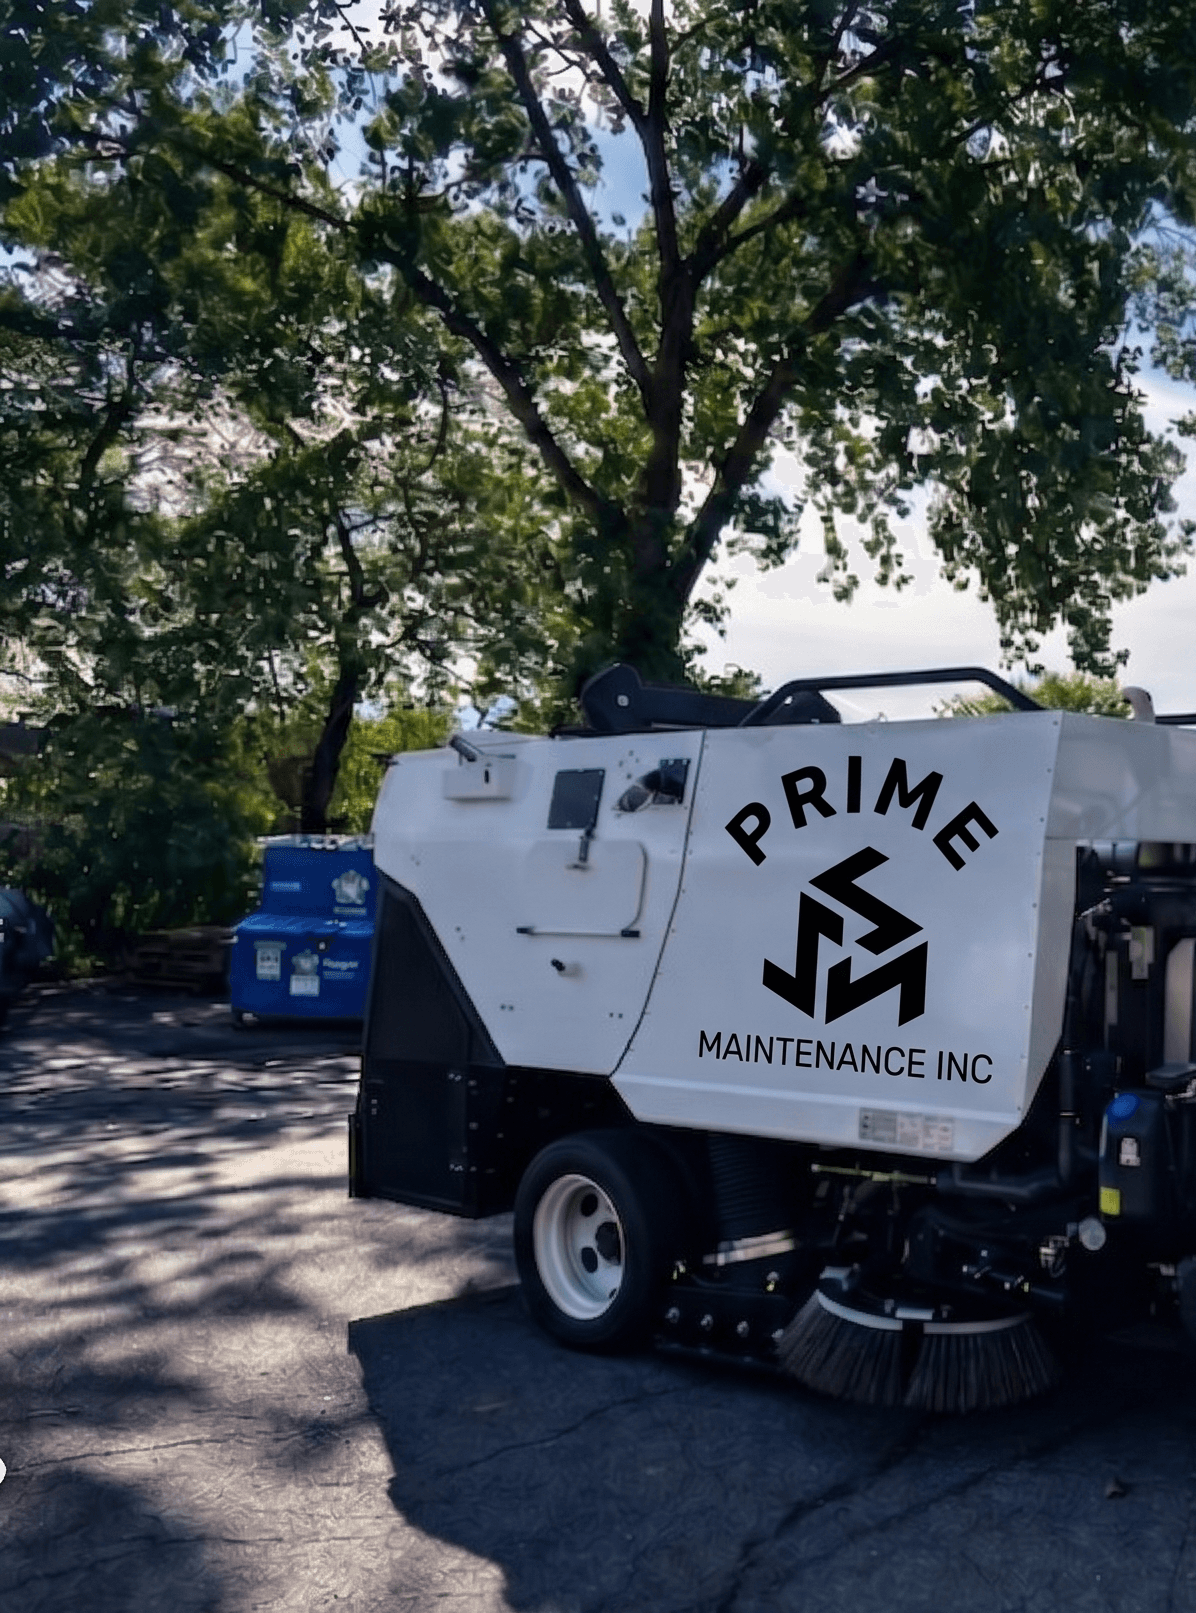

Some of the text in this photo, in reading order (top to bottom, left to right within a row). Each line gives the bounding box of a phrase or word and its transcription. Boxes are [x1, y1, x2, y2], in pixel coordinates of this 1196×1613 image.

[725, 755, 1000, 872] PRIME
[698, 1029, 994, 1085] MAINTENANCE INC
